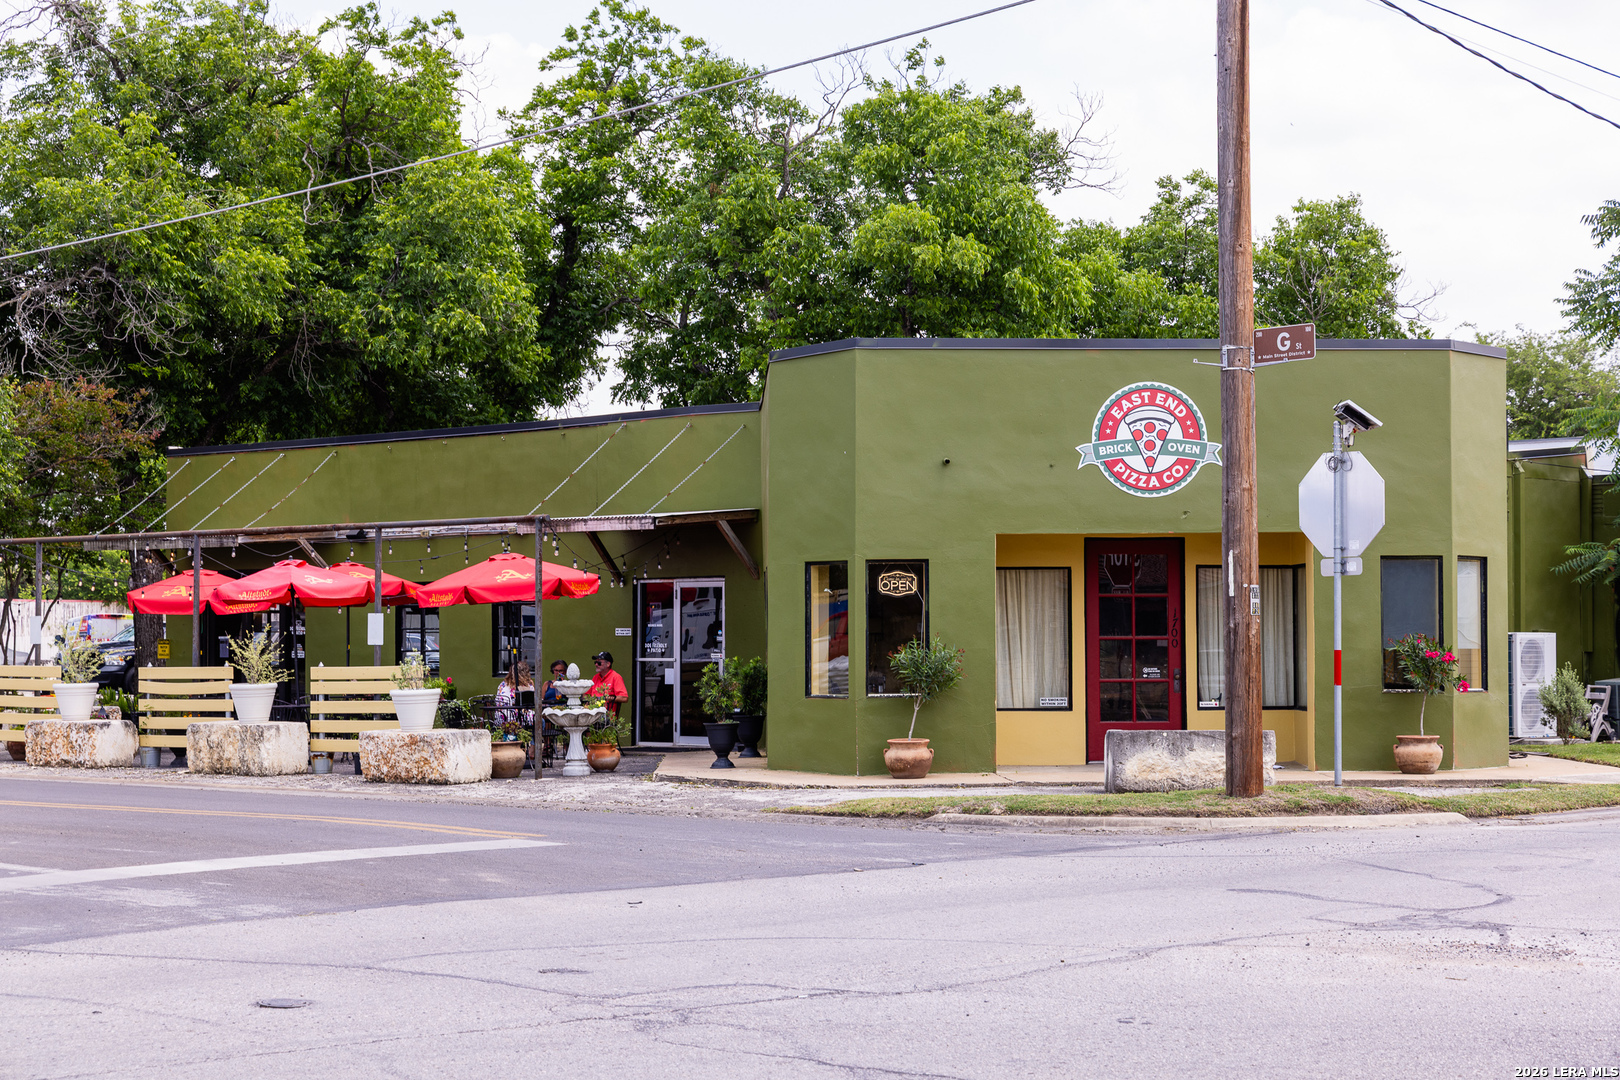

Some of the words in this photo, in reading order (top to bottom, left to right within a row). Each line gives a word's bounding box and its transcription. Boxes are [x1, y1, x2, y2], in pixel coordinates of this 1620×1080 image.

[1276, 332, 1291, 352] G
[1111, 392, 1150, 420] EAST
[1156, 392, 1187, 418] END
[1098, 443, 1133, 456] BRICK
[1168, 443, 1200, 454] OVEN
[1113, 462, 1160, 488] PIZZA
[1162, 464, 1189, 483] CO.
[881, 581, 914, 590] OPEN
